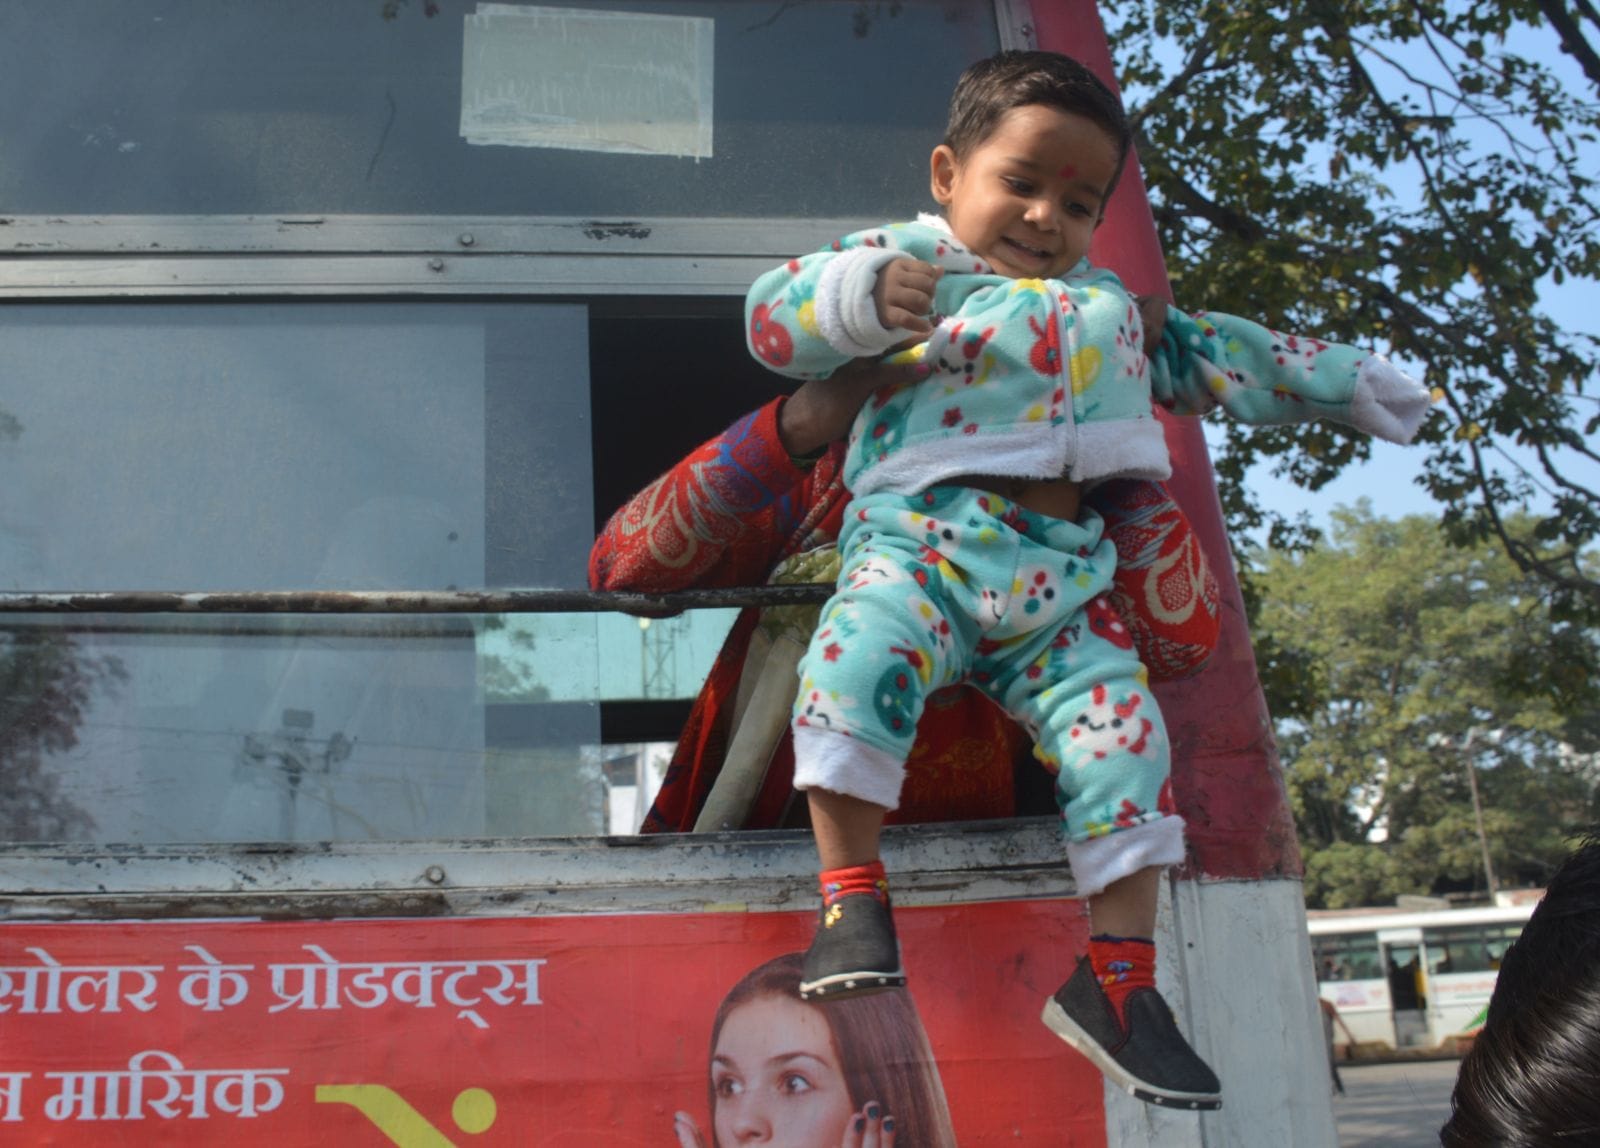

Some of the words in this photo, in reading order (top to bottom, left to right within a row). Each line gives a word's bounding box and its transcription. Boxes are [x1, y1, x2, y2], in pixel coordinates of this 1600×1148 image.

[177, 945, 255, 1011] के
[268, 944, 547, 1029] प्रोडक्ट्स
[44, 1050, 290, 1121] मासिक
